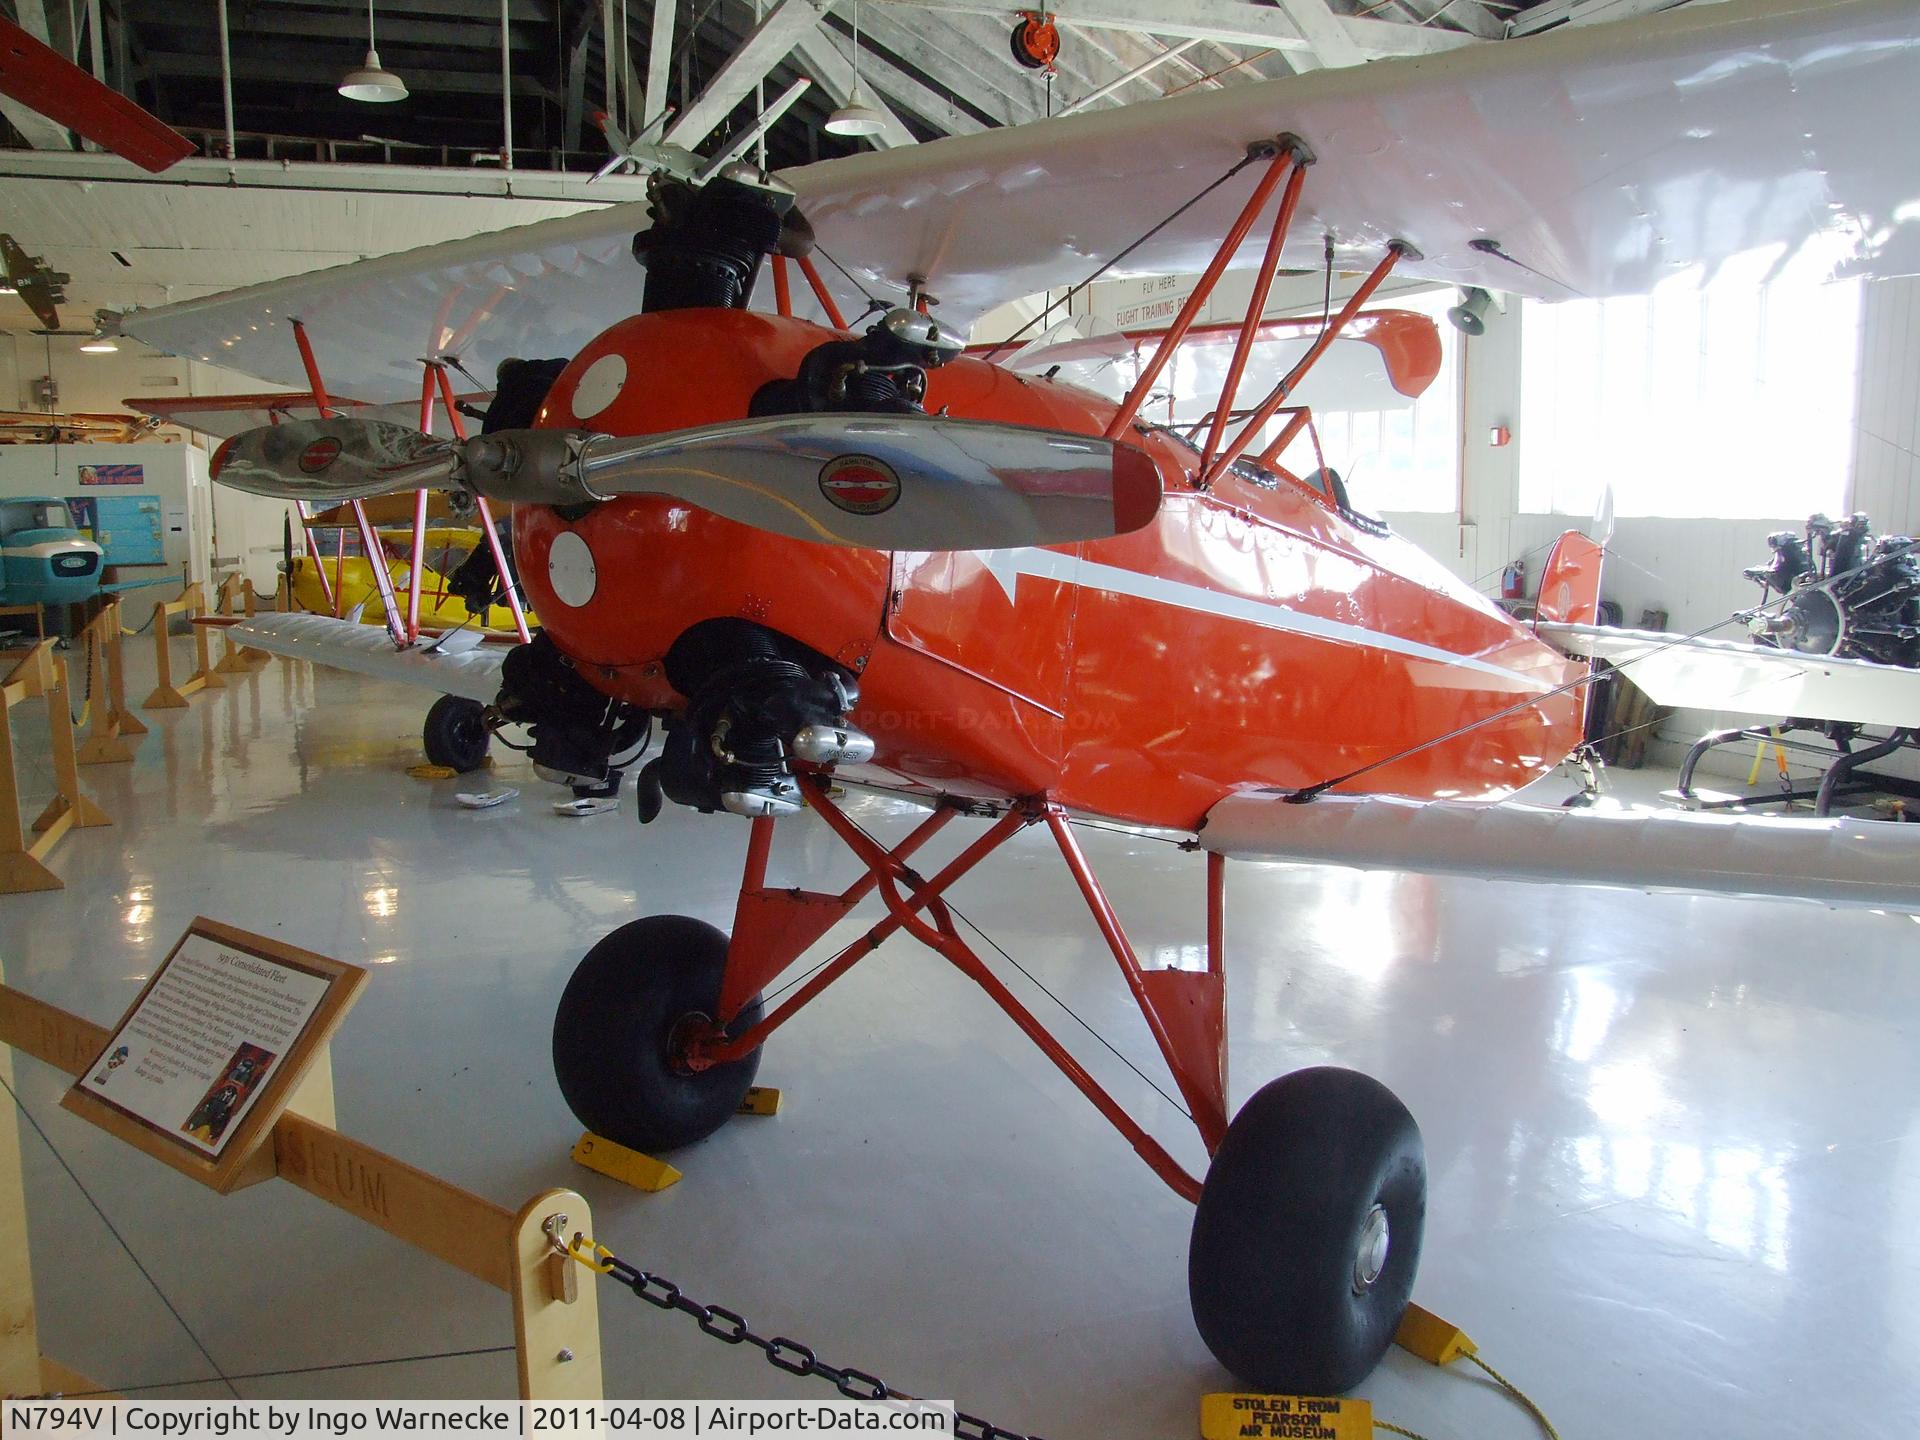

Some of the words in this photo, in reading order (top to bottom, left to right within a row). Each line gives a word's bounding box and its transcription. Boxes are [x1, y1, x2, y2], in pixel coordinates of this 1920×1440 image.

[1142, 282, 1154, 295] FLY
[1159, 275, 1176, 290] HERE
[1116, 308, 1139, 327] FLIGHT
[1141, 300, 1174, 321] TRAINING
[824, 748, 861, 760] KINNER
[230, 955, 271, 978] Consolidated
[270, 968, 289, 984] Fleet
[1233, 1398, 1290, 1413] STOLEN
[1298, 1400, 1341, 1414] FROM
[1252, 1411, 1322, 1427] PEARSON
[1239, 1424, 1263, 1437] AIR
[1270, 1425, 1336, 1440] MUSEUM
